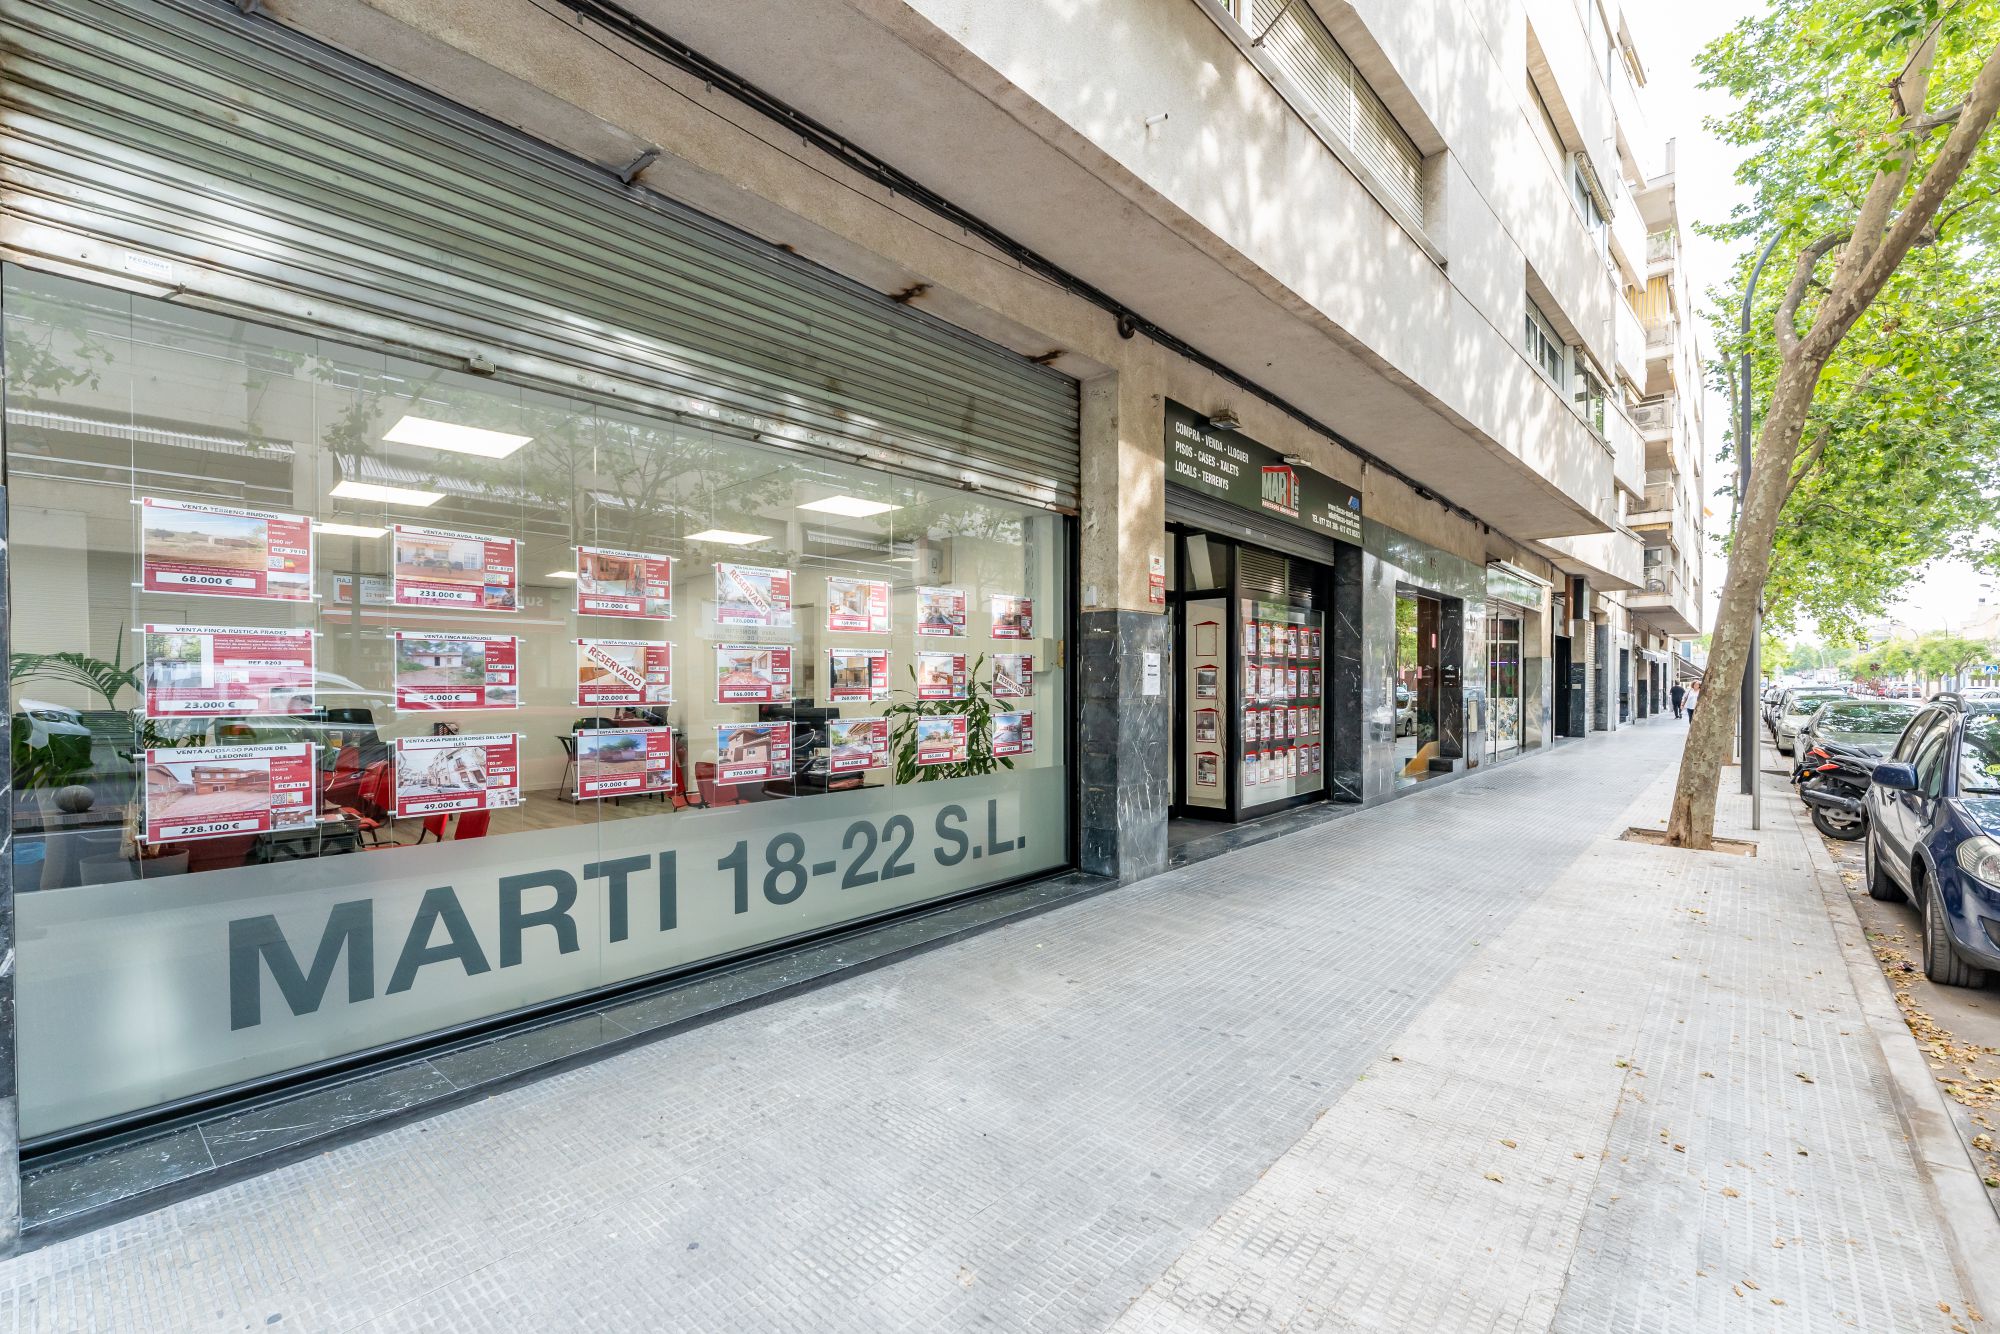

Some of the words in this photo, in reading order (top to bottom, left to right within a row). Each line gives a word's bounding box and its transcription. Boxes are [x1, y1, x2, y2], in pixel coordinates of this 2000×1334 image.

[1175, 421, 1201, 442] COMPRA
[1205, 434, 1223, 453] VENDA
[1227, 444, 1249, 464] LLOGUER
[1175, 440, 1193, 458] PISOS
[1198, 450, 1216, 467] CASES
[1220, 459, 1239, 477] XALETS
[1175, 460, 1197, 479] LOCALS
[1202, 470, 1229, 490] TERRENYS
[181, 503, 208, 511] VENTA
[210, 507, 245, 515] TERRENO
[181, 575, 223, 585] 68.000
[225, 578, 233, 586] €
[419, 590, 455, 598] 233.000
[729, 569, 768, 613] RESERVADO
[588, 646, 641, 687] RESERVADO
[998, 676, 1024, 696] RESERVADO
[184, 701, 225, 709] 23.000
[424, 801, 454, 810] 49.000
[181, 824, 230, 834] 228.100
[228, 850, 678, 1030] MARTI
[718, 815, 916, 915] 18-22
[935, 800, 1027, 868] S.L.
